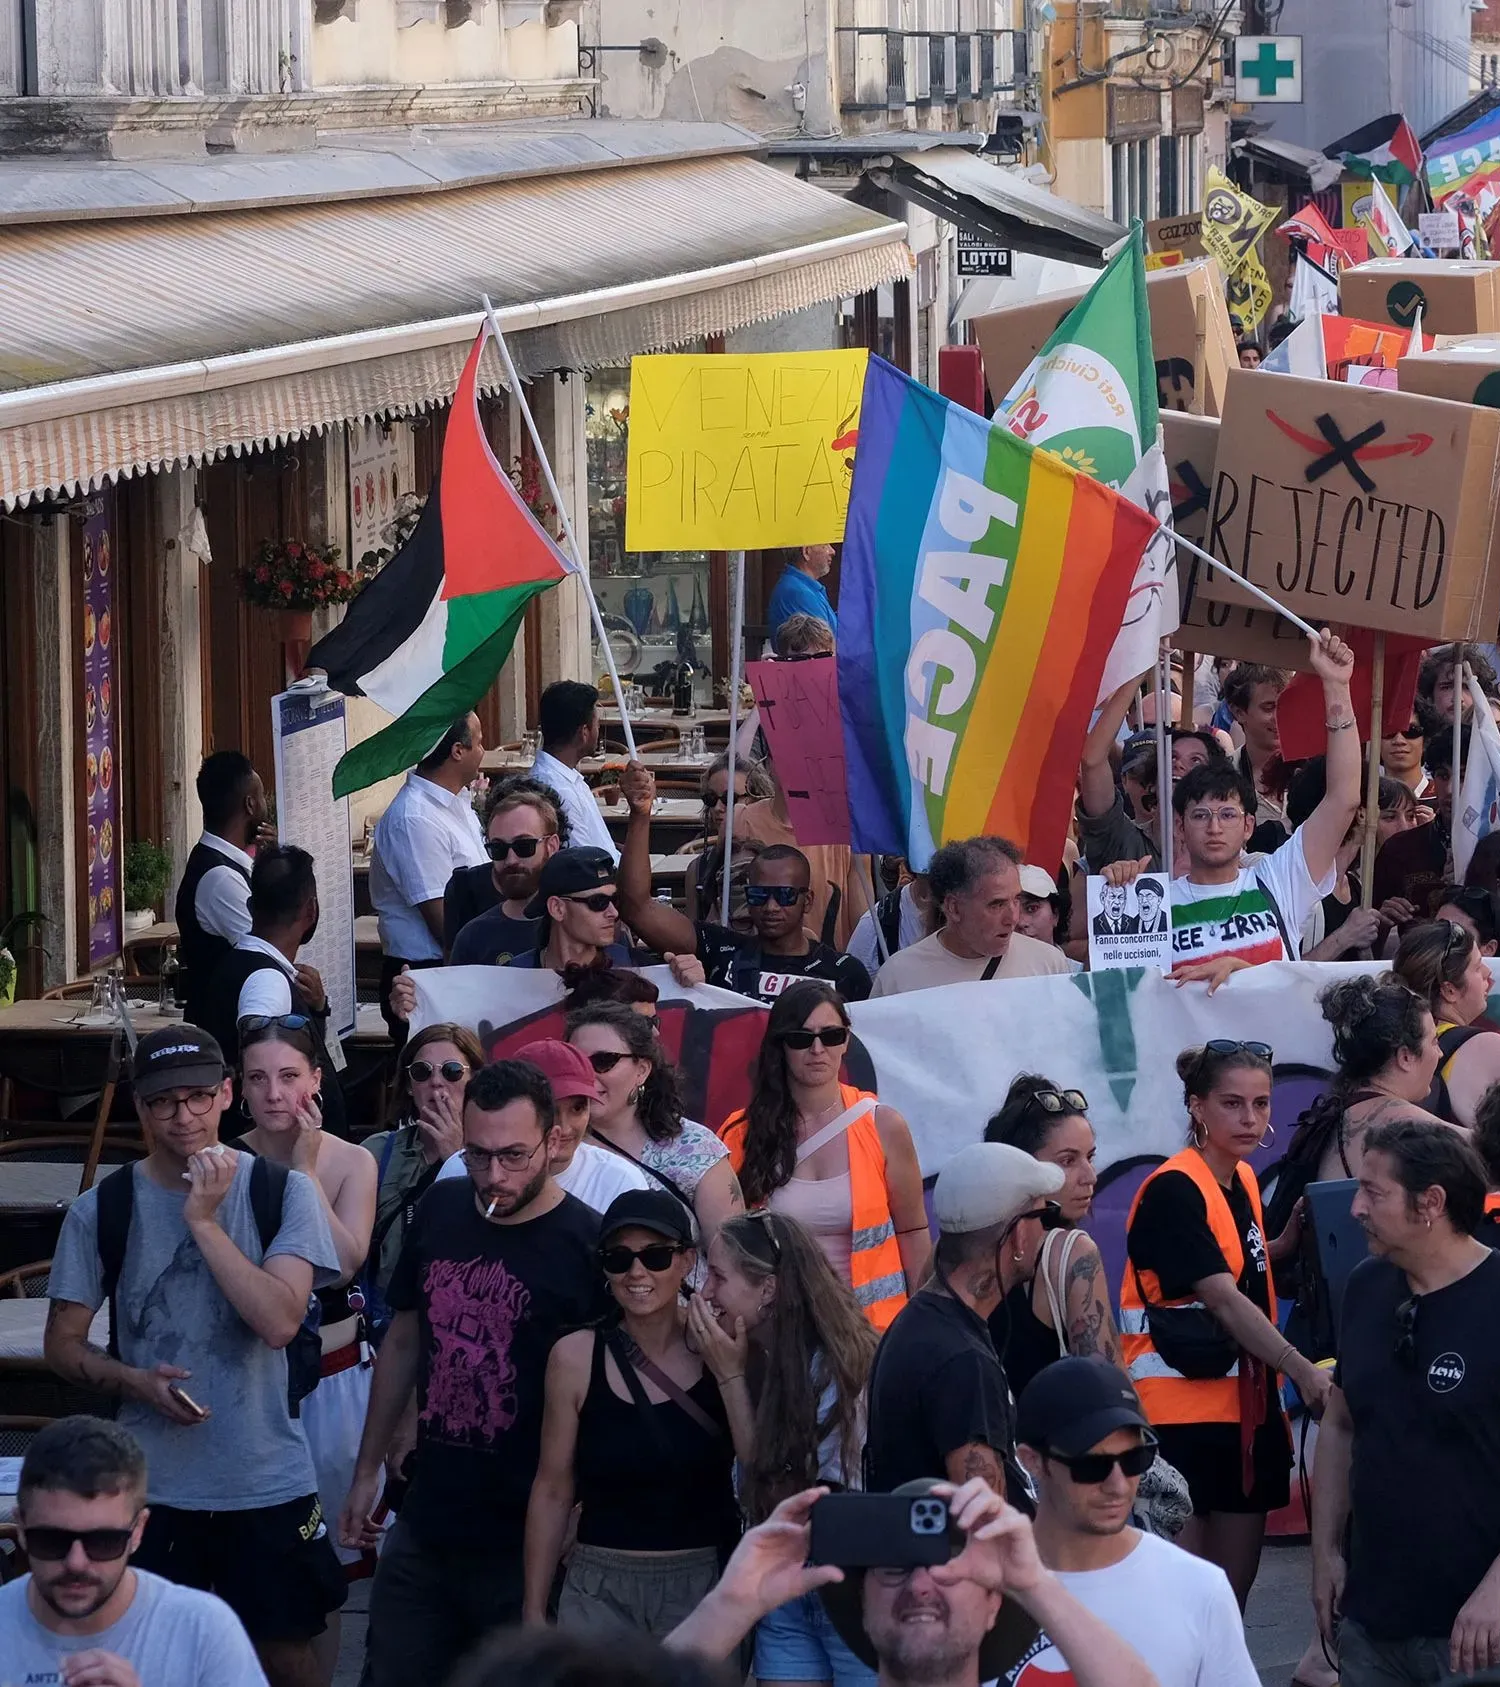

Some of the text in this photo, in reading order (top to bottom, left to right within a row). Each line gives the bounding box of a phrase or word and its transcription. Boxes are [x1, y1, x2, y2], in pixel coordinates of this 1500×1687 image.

[961, 251, 1008, 266] LOTTO
[637, 362, 863, 432] VENEZIA
[638, 436, 850, 526] PIRATA
[1206, 470, 1446, 611] REJECTED
[1095, 932, 1168, 945] Fanno concorrenza
[1171, 909, 1278, 953] REE IRAN
[1103, 949, 1162, 961] nelle uccisioni,
